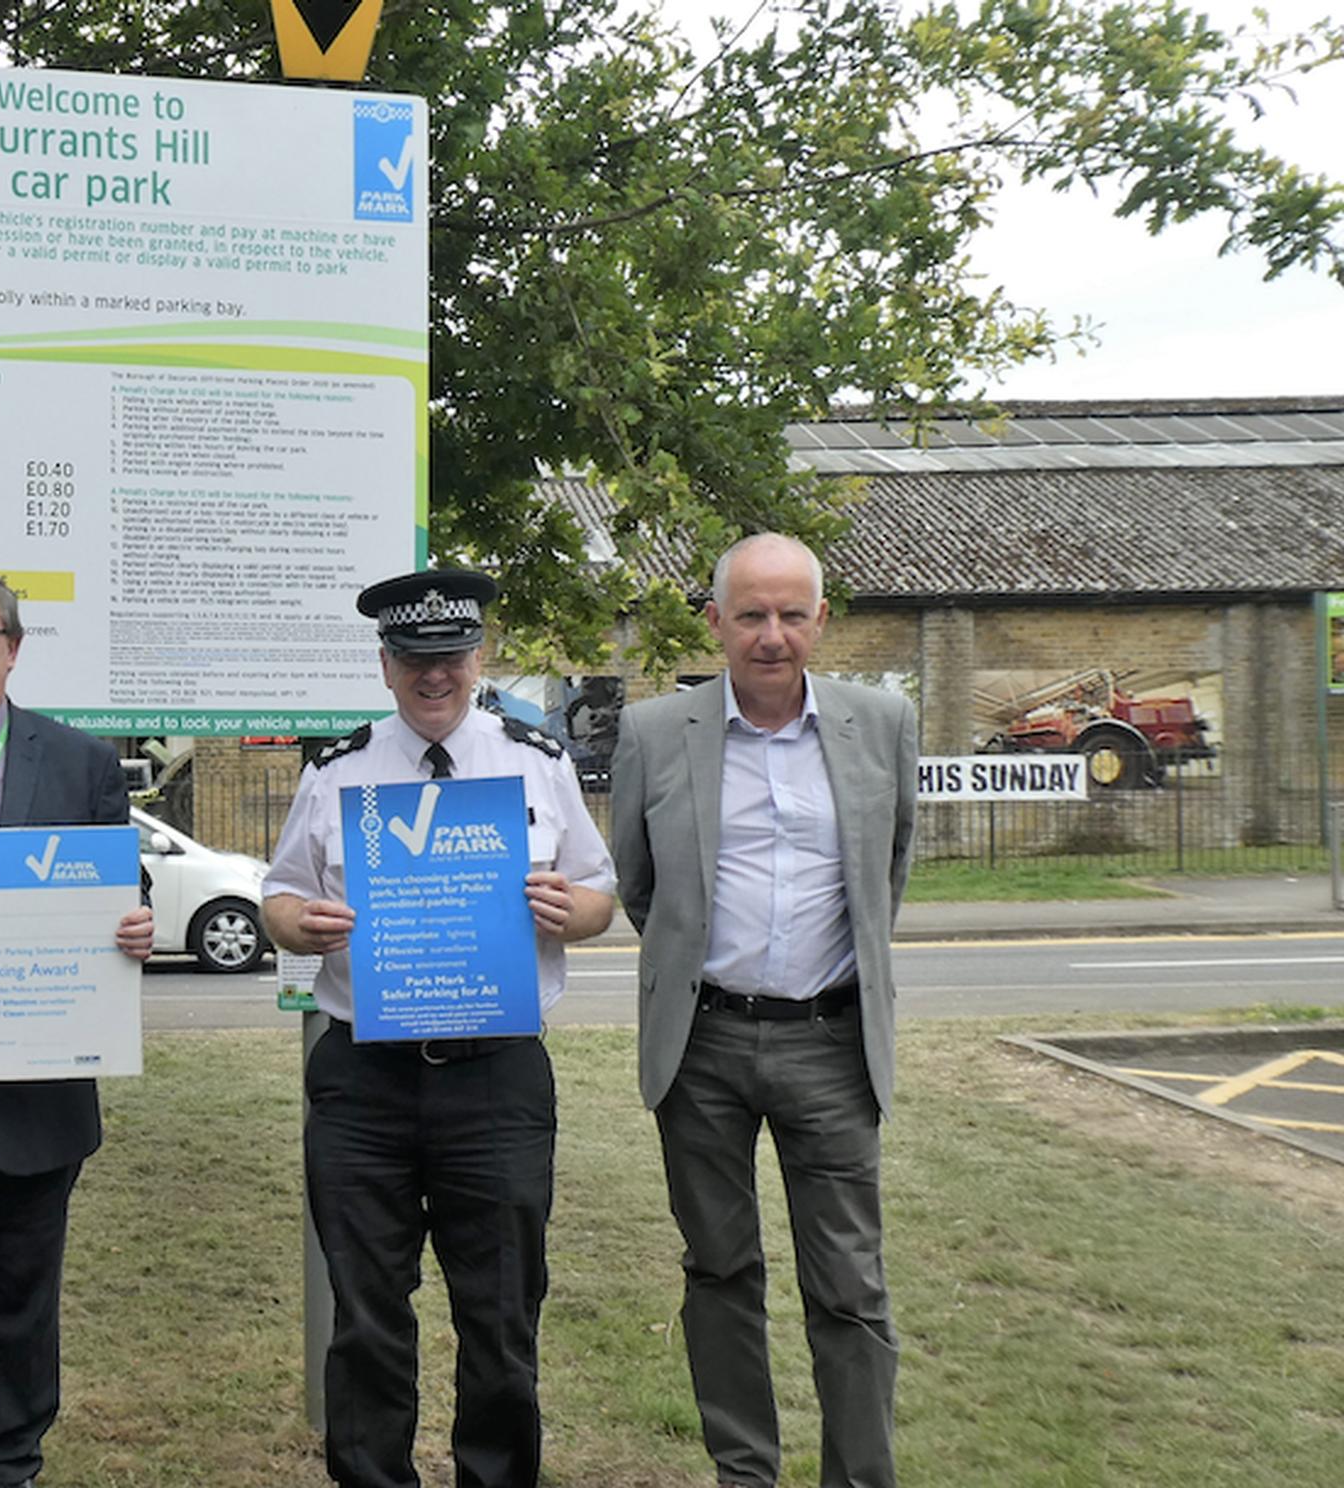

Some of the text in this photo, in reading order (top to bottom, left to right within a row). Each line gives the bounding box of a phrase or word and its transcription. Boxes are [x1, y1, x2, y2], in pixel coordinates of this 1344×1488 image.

[153, 92, 184, 120] to
[154, 130, 209, 165] Hill
[11, 170, 171, 206] car park
[360, 192, 404, 201] PARK
[358, 202, 408, 214] MARK
[49, 214, 135, 235] registration
[140, 219, 194, 235] number
[200, 223, 225, 237] and
[231, 227, 257, 242] pay
[262, 226, 274, 240] at
[281, 227, 337, 244] machine
[343, 234, 357, 245] or
[363, 232, 395, 247] have
[46, 233, 61, 244] or
[69, 232, 103, 247] have
[108, 234, 144, 249] been
[214, 240, 227, 253] in
[232, 241, 284, 259] respect
[290, 244, 303, 258] to
[310, 245, 332, 259] the
[8, 247, 15, 257] a
[22, 245, 57, 260] valid
[63, 247, 109, 265] permit
[115, 253, 130, 263] or
[136, 251, 187, 269] display
[193, 257, 201, 267] a
[207, 255, 239, 269] valid
[246, 257, 292, 274] permit
[298, 259, 310, 273] to
[316, 260, 347, 277] park
[30, 291, 75, 308] within
[81, 298, 89, 308] a
[95, 295, 150, 312] marked
[156, 298, 211, 318] parking
[26, 462, 74, 478] £0.40
[26, 482, 74, 498] £0.80
[26, 501, 71, 518] £1.20
[26, 521, 70, 537] £1.70
[136, 716, 160, 729] and
[164, 716, 178, 729] to
[181, 715, 210, 729] lock
[215, 718, 242, 732] your
[247, 716, 291, 730] vehicle
[296, 716, 329, 730] when
[971, 763, 1080, 792] SUNDAY
[434, 824, 499, 839] PARK
[430, 837, 508, 855] MARK
[55, 861, 95, 870] PARK
[52, 870, 100, 880] MARK
[30, 961, 79, 976] Award
[406, 974, 465, 986] Park Mark
[381, 985, 498, 1000] Safer Parking for All
